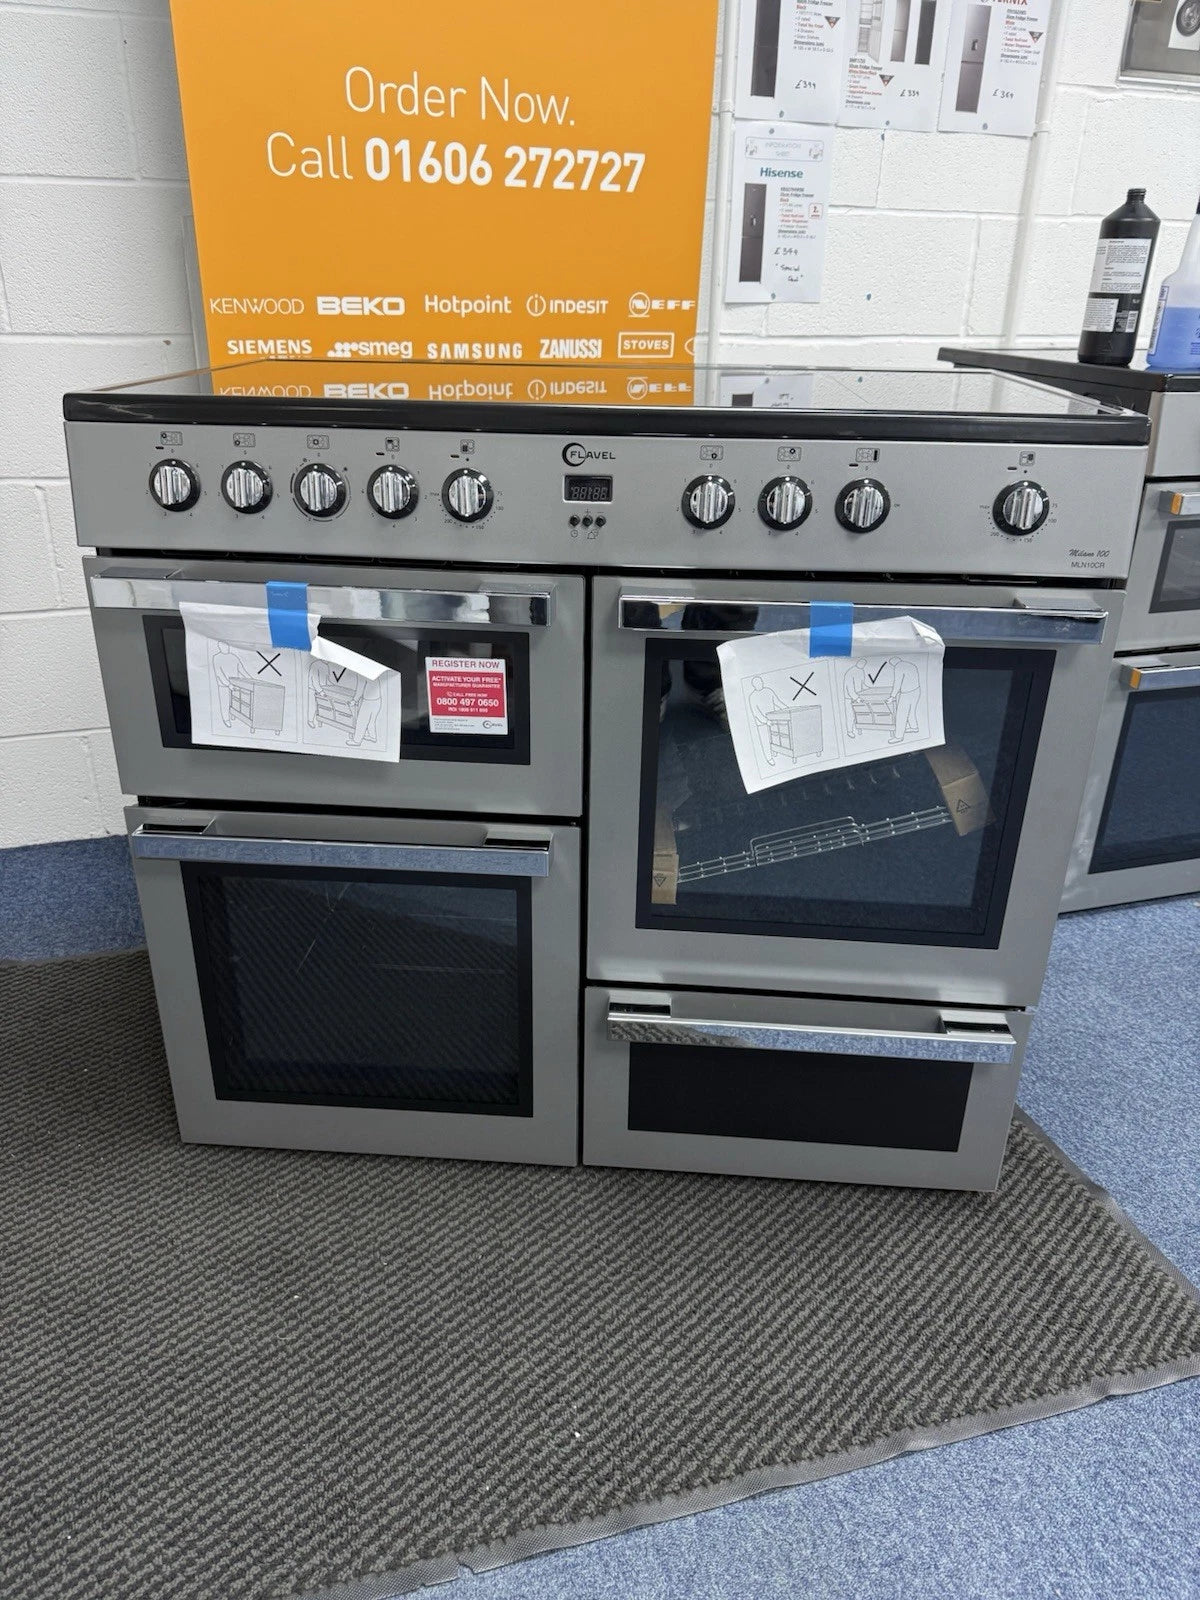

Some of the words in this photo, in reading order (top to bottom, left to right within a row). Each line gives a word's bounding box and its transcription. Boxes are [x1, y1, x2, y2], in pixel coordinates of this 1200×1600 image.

[345, 66, 467, 119] Order
[480, 76, 576, 126] Now.
[266, 132, 353, 180] Call
[364, 137, 493, 186] 01606
[504, 146, 646, 193] 272727
[760, 167, 804, 178] Hisense
[209, 297, 305, 315] KENWOOD
[317, 296, 405, 316] BEKO
[424, 294, 512, 318] Hotpoint
[629, 292, 696, 317] NEFF
[227, 339, 312, 355] SIEMENS
[358, 341, 413, 359] smeg
[427, 342, 523, 360] SAMSUNG
[540, 339, 602, 359] ZANUSSI
[623, 340, 670, 350] STOVES
[432, 659, 476, 668] REGISTER
[478, 660, 500, 669] NOW
[478, 699, 500, 707] 0650
